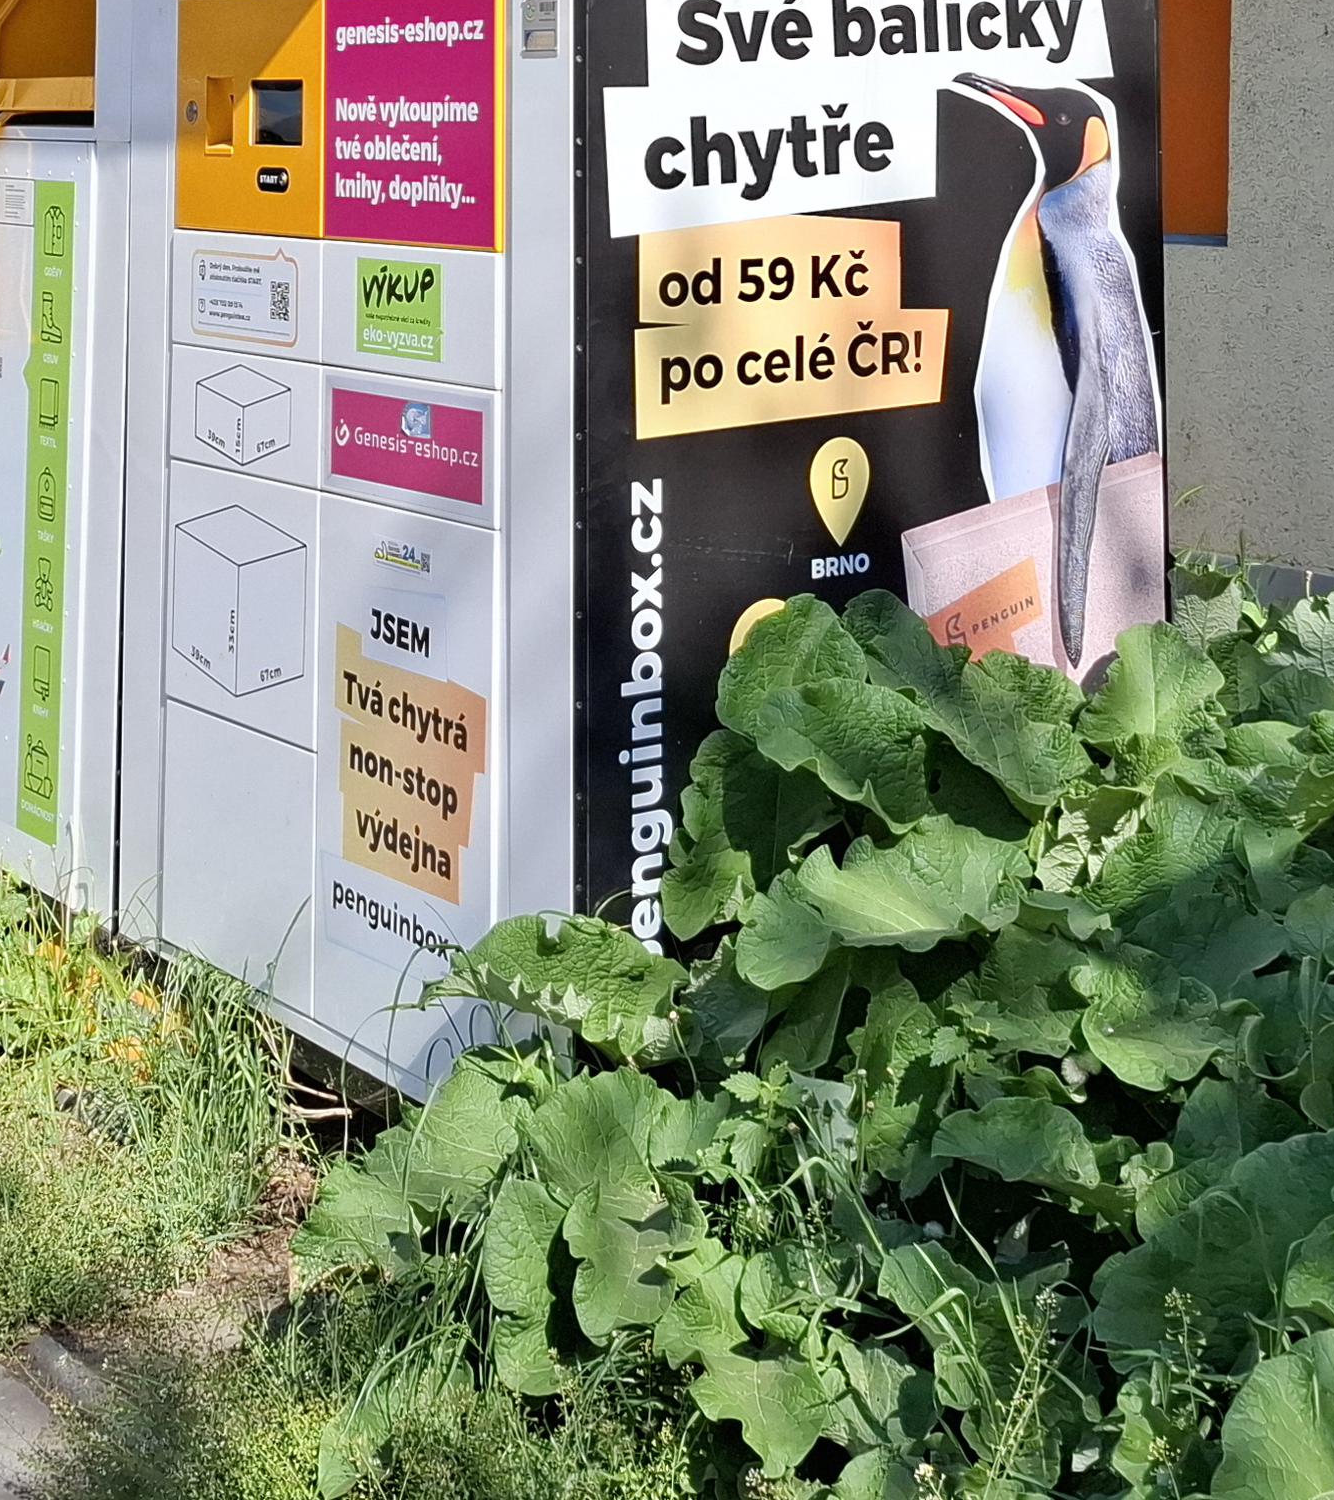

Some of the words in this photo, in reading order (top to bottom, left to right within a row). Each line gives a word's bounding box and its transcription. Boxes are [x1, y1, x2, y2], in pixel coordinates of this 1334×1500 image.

[336, 17, 484, 51] genesis-eshop.cz
[336, 96, 376, 124] Nově
[379, 97, 479, 128] vykoupíme
[336, 136, 361, 161] tvé
[364, 134, 442, 165] oblečení,
[644, 103, 894, 201] chytře
[335, 173, 386, 204] knihy,
[389, 174, 475, 207] doplňky...
[363, 265, 434, 309] VÝKUP
[658, 257, 722, 308] od
[737, 258, 795, 302] 59
[810, 250, 870, 299] Kč
[363, 324, 434, 349] eko-vyzva.cz
[660, 355, 723, 406] po
[736, 332, 835, 386] celé
[848, 320, 923, 377] ČR!
[355, 427, 478, 467] Genesis-eshop.cz
[810, 552, 870, 580] BRNO
[370, 608, 430, 657] JSEM
[971, 596, 1034, 635] PENGUIN
[191, 645, 211, 670] 39cm
[260, 668, 282, 682] 67cm
[343, 671, 383, 717] Tvá
[389, 692, 468, 752] chytrá
[619, 478, 672, 956] enguinbox.cz
[349, 742, 458, 820] non-stop
[356, 808, 451, 881] výdejna
[333, 880, 449, 962] penguinbox
